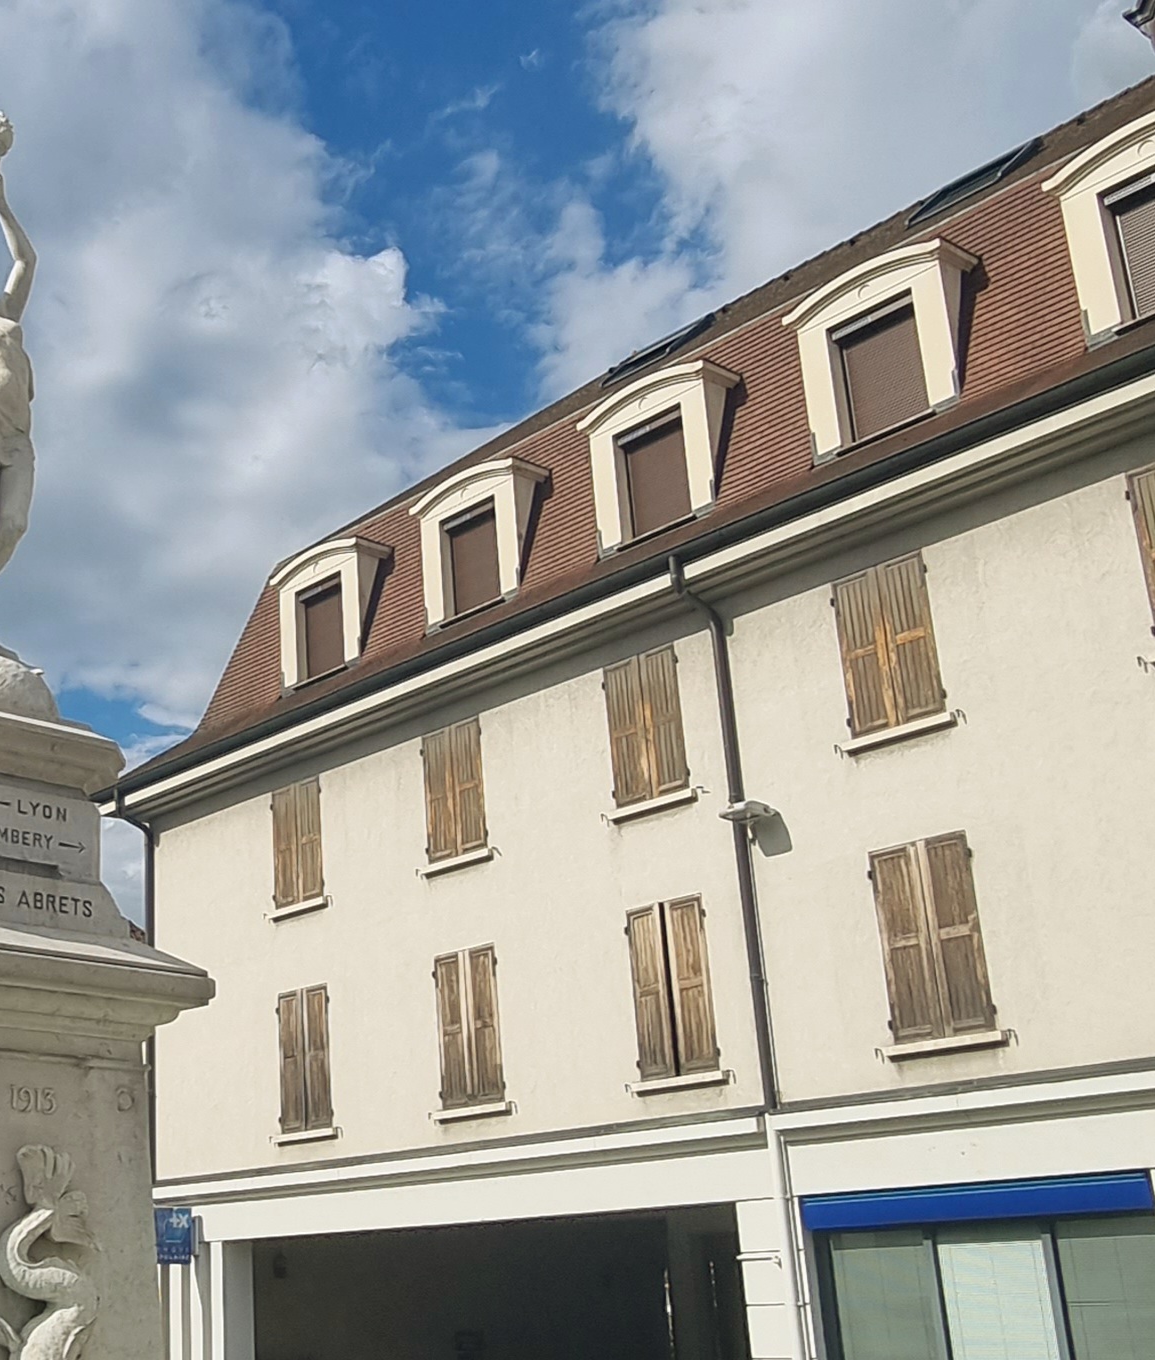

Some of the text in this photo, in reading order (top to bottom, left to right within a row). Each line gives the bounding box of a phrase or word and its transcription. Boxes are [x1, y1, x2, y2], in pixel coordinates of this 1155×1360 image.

[18, 799, 67, 822] LYON
[17, 890, 93, 918] ABRETS
[10, 1084, 56, 1114] 1913
